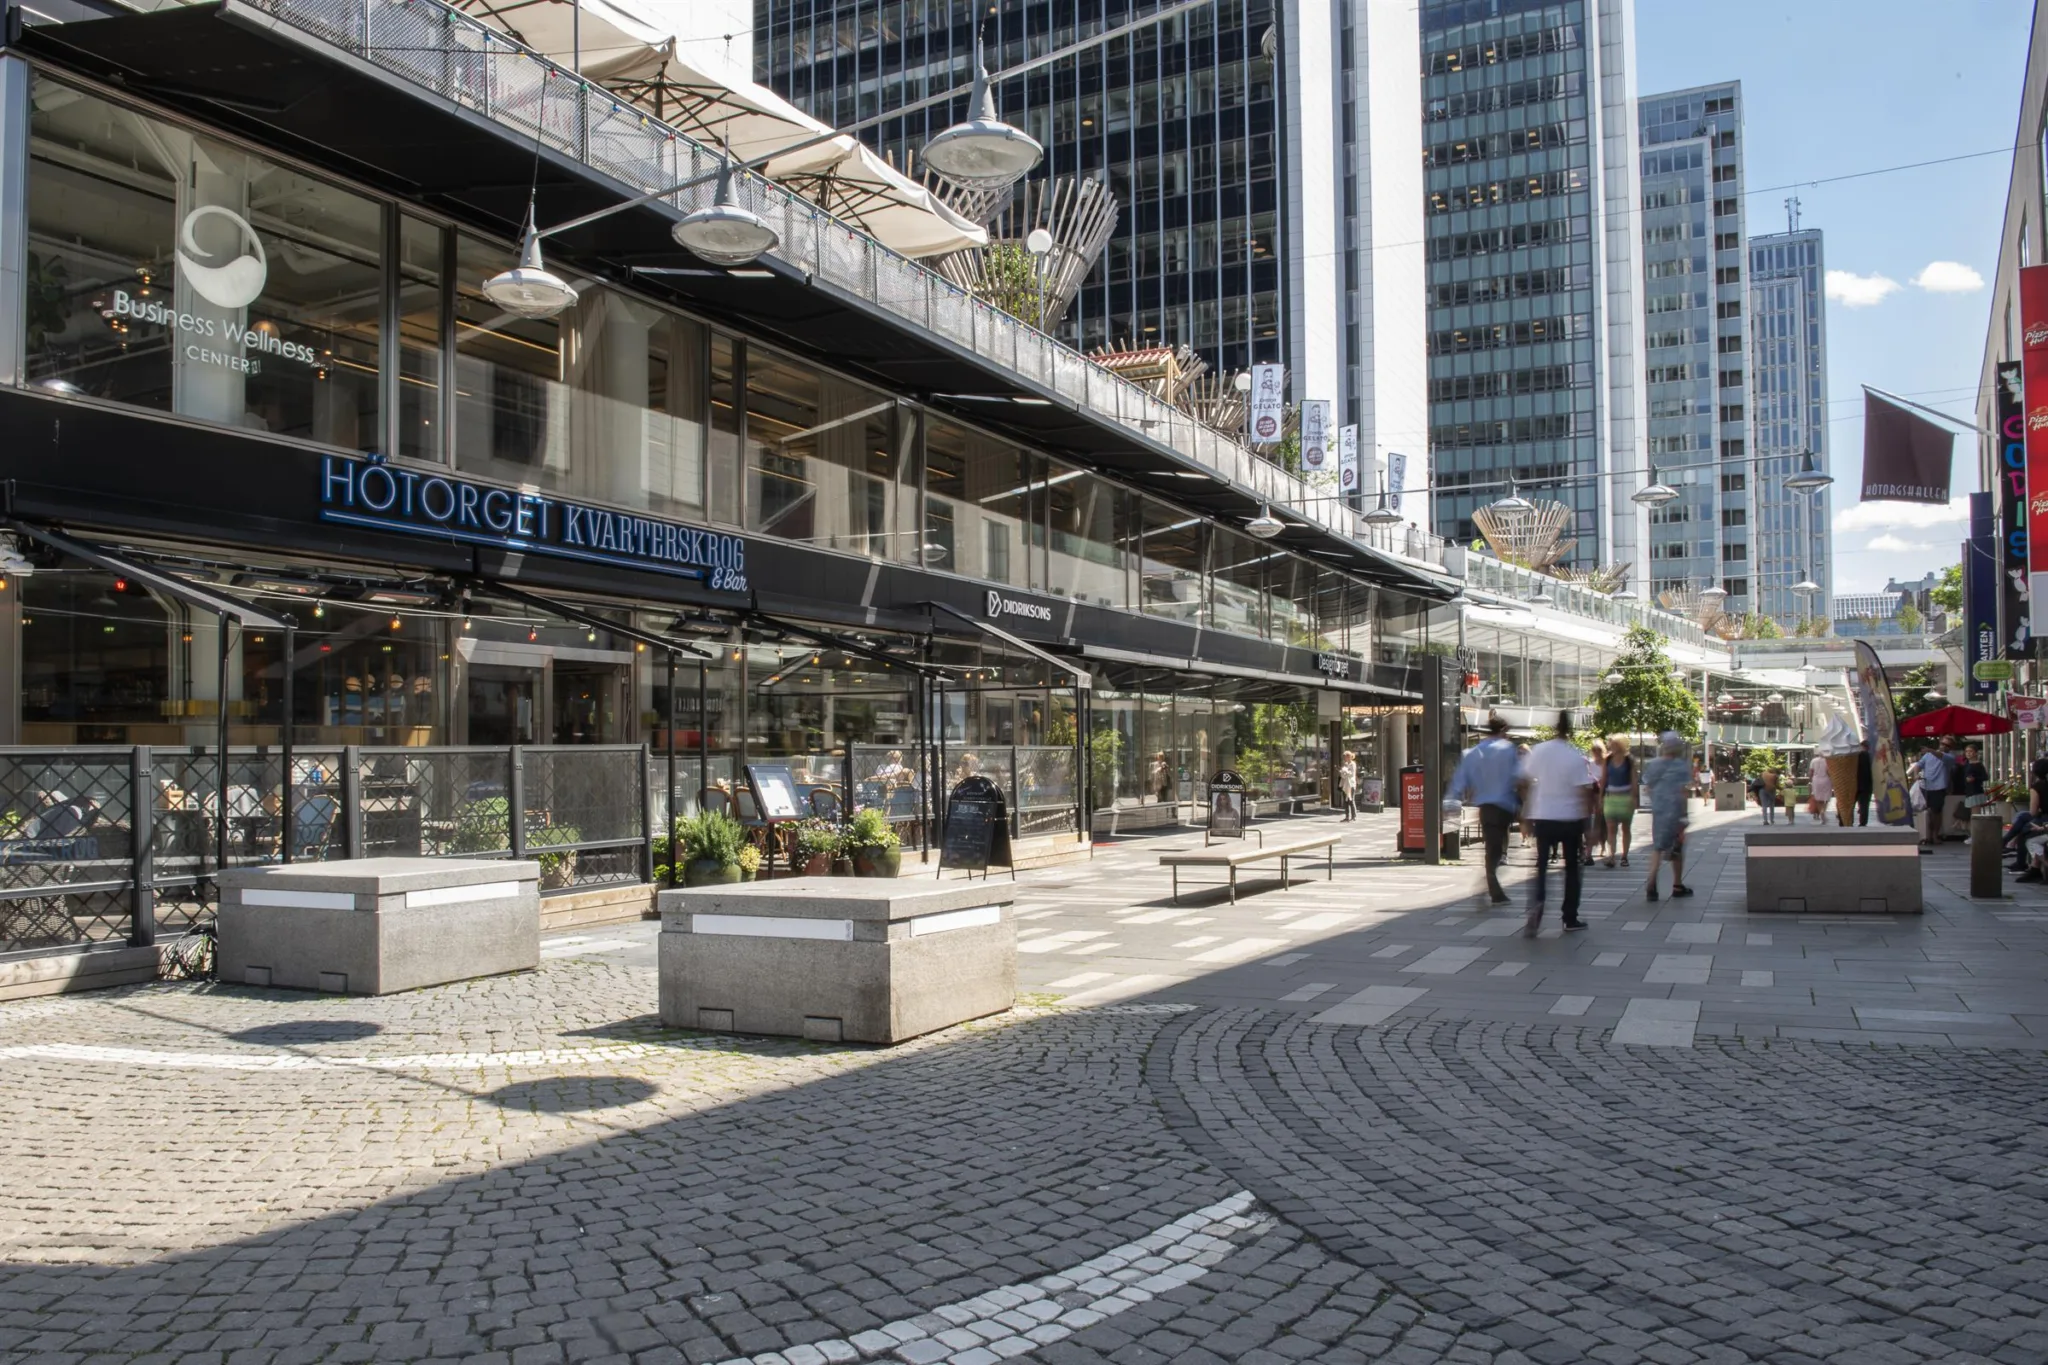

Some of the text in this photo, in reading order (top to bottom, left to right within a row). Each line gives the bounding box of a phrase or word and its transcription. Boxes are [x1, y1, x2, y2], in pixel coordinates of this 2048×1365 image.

[113, 290, 316, 364] Business Wellness
[187, 346, 250, 372] CENTER
[323, 454, 745, 572] HÖTORGET KVARTERSKROG
[723, 570, 748, 592] Bar
[1003, 599, 1052, 621] DIDRIKSONS
[1980, 630, 1989, 689] EANTEN
